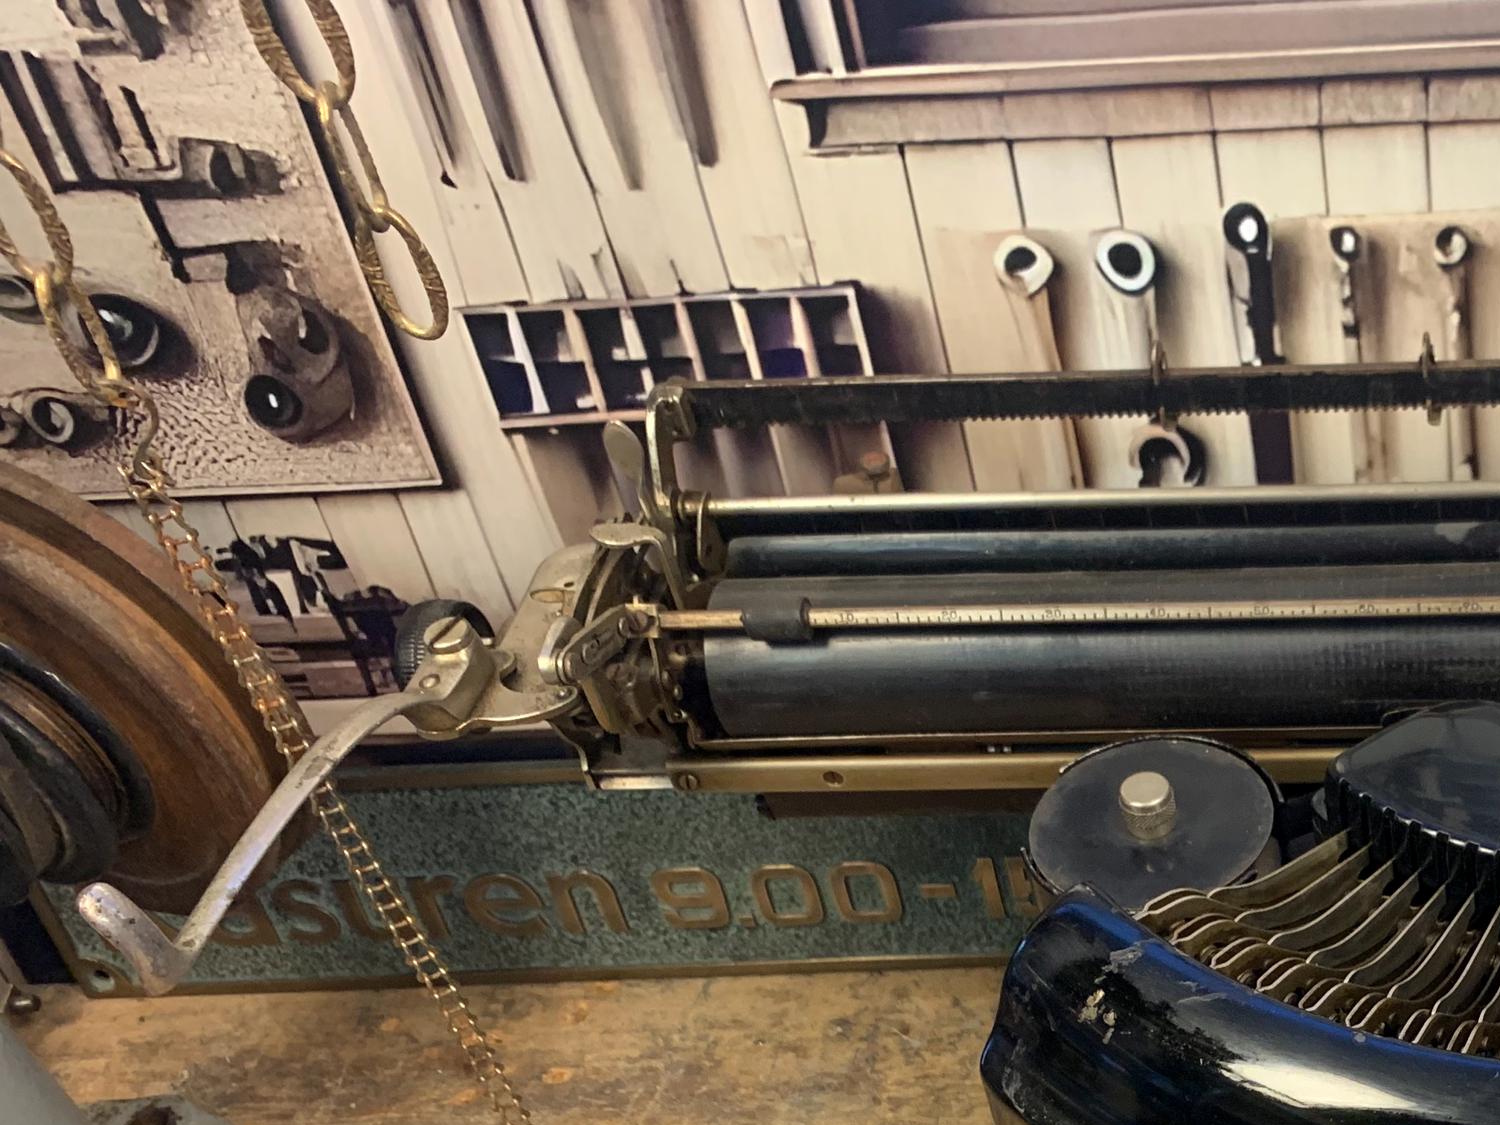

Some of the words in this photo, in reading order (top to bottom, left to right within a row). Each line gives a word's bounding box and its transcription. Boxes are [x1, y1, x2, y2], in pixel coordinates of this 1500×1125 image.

[839, 612, 855, 623] 10
[941, 610, 958, 620] 20
[1046, 609, 1062, 619] 30
[1150, 607, 1166, 617] 40
[1253, 606, 1270, 616] 50
[1359, 604, 1375, 614] 60
